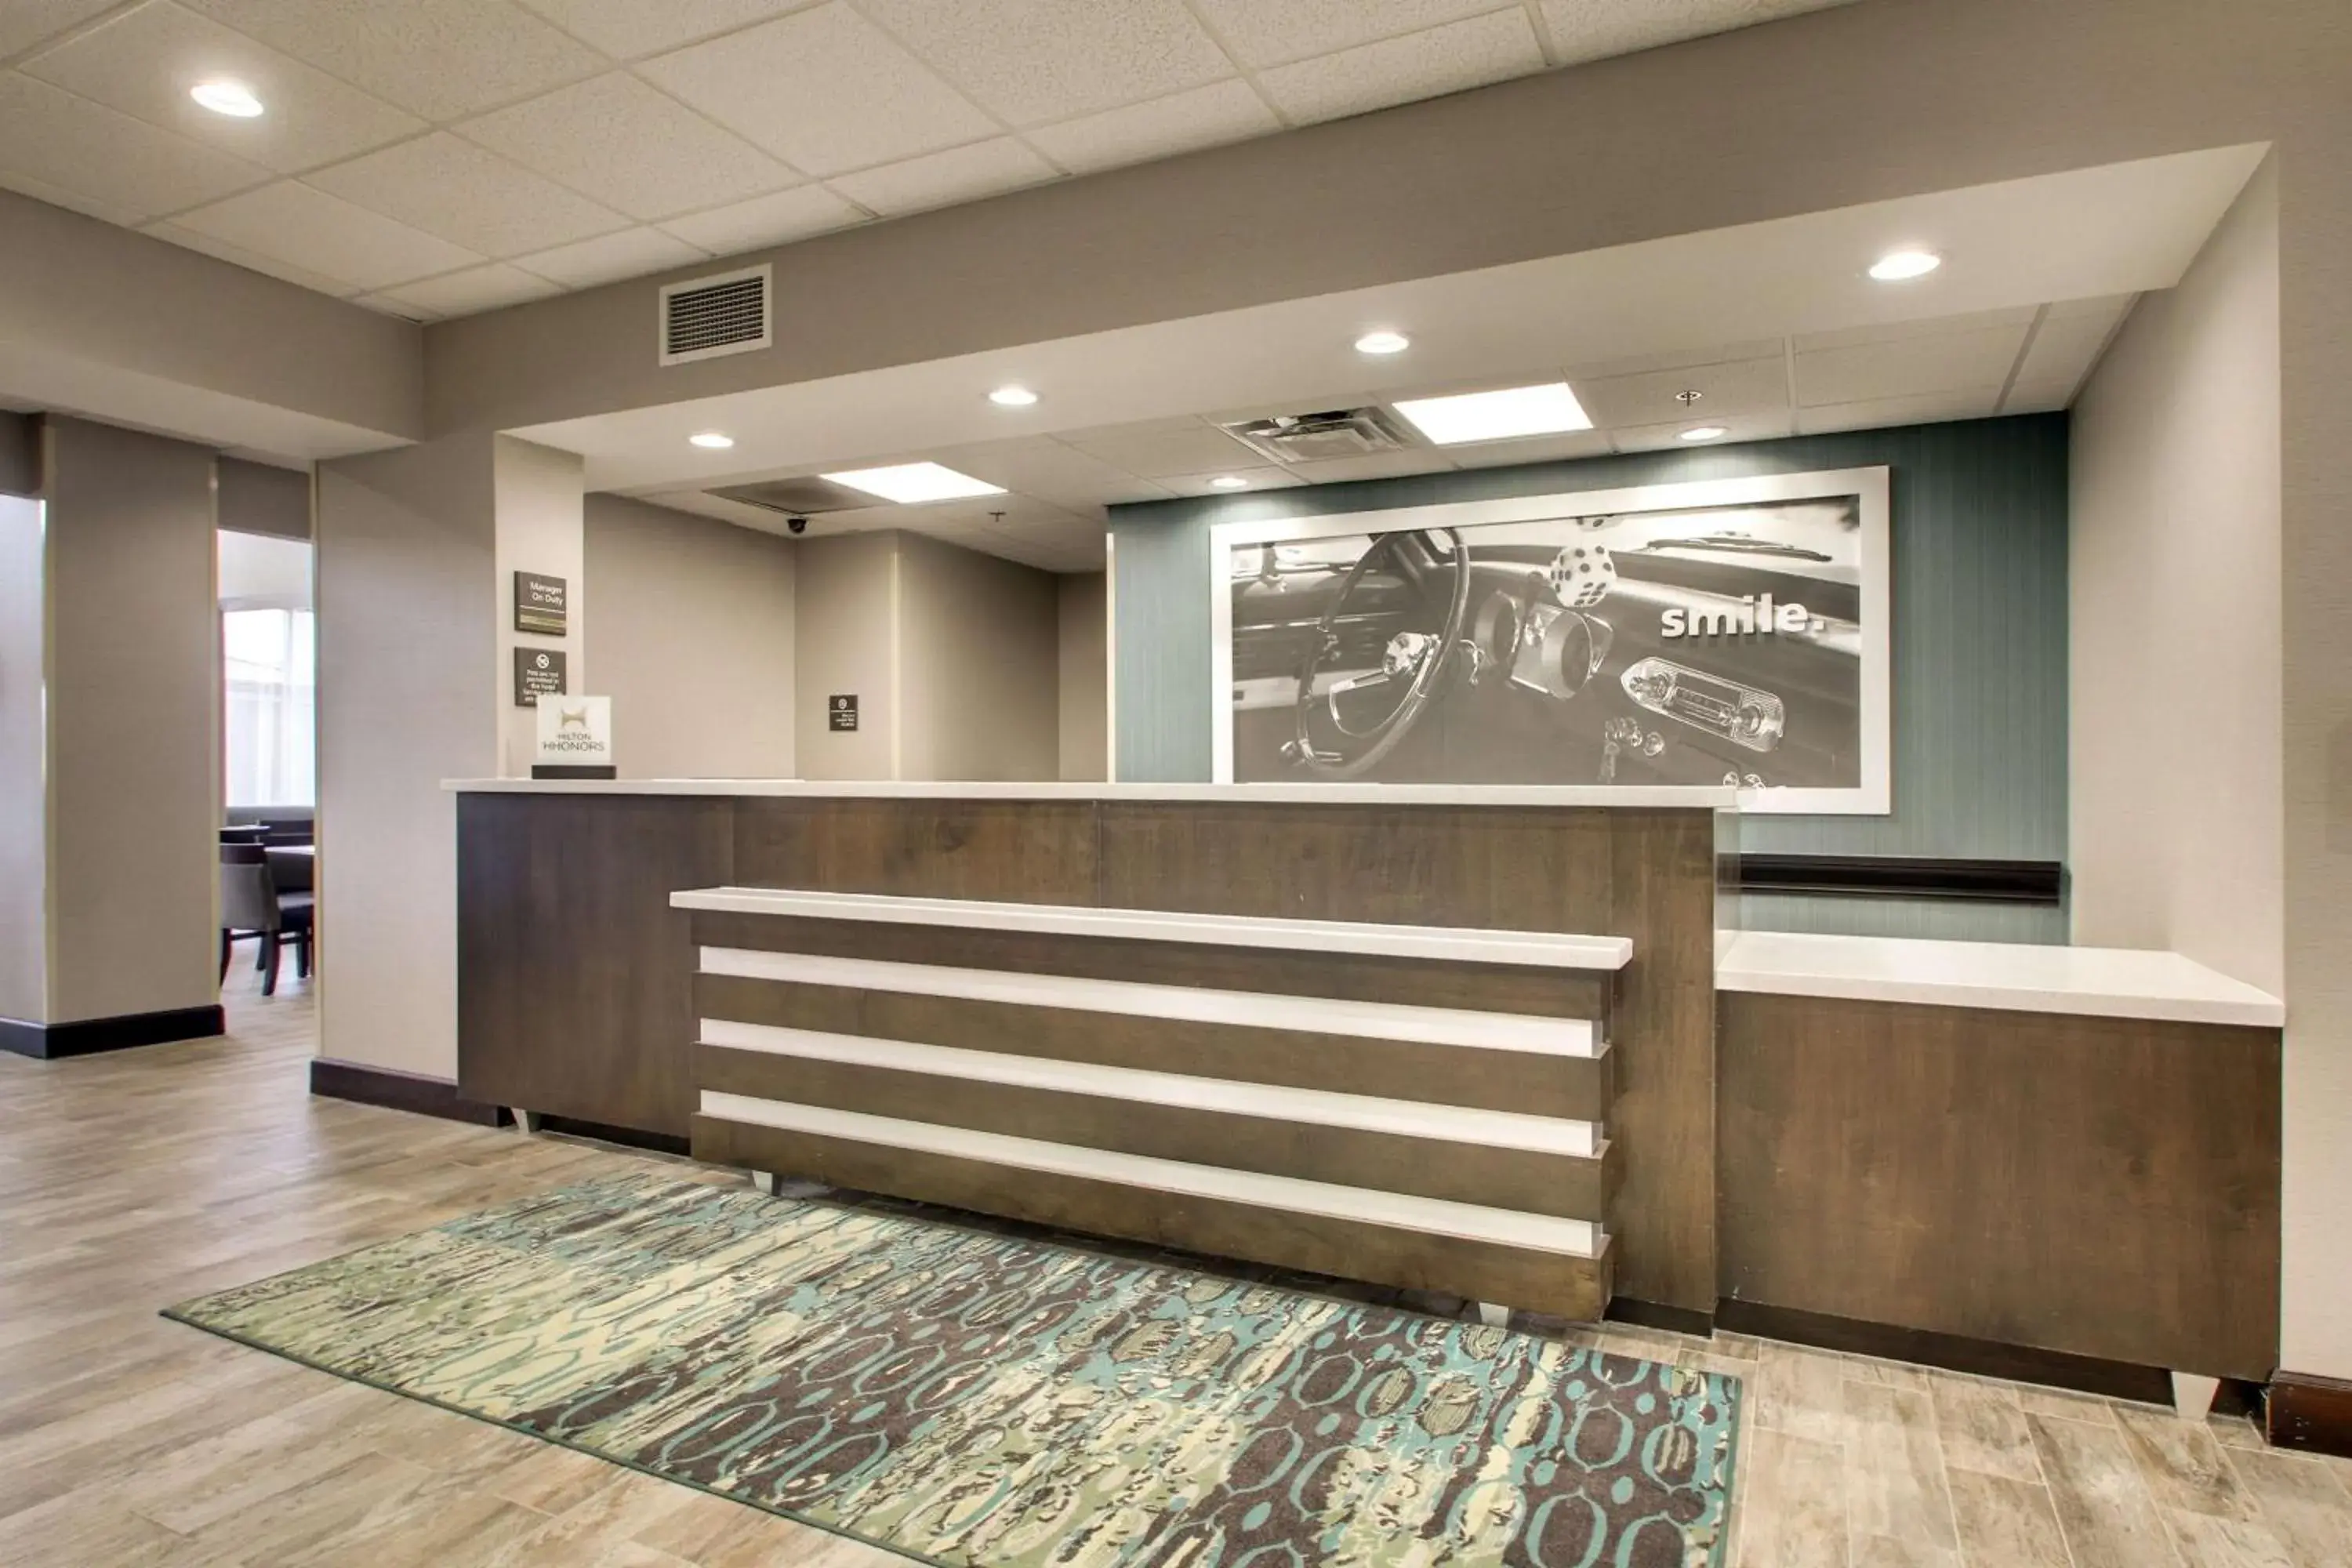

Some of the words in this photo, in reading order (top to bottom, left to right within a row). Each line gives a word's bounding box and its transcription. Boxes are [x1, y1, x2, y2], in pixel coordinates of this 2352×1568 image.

[530, 582, 563, 594] Manager
[532, 592, 543, 601] On
[545, 594, 564, 606] Duty
[1661, 593, 1825, 637] smile.
[557, 732, 591, 741] HILTON
[543, 741, 605, 751] HHONORS
